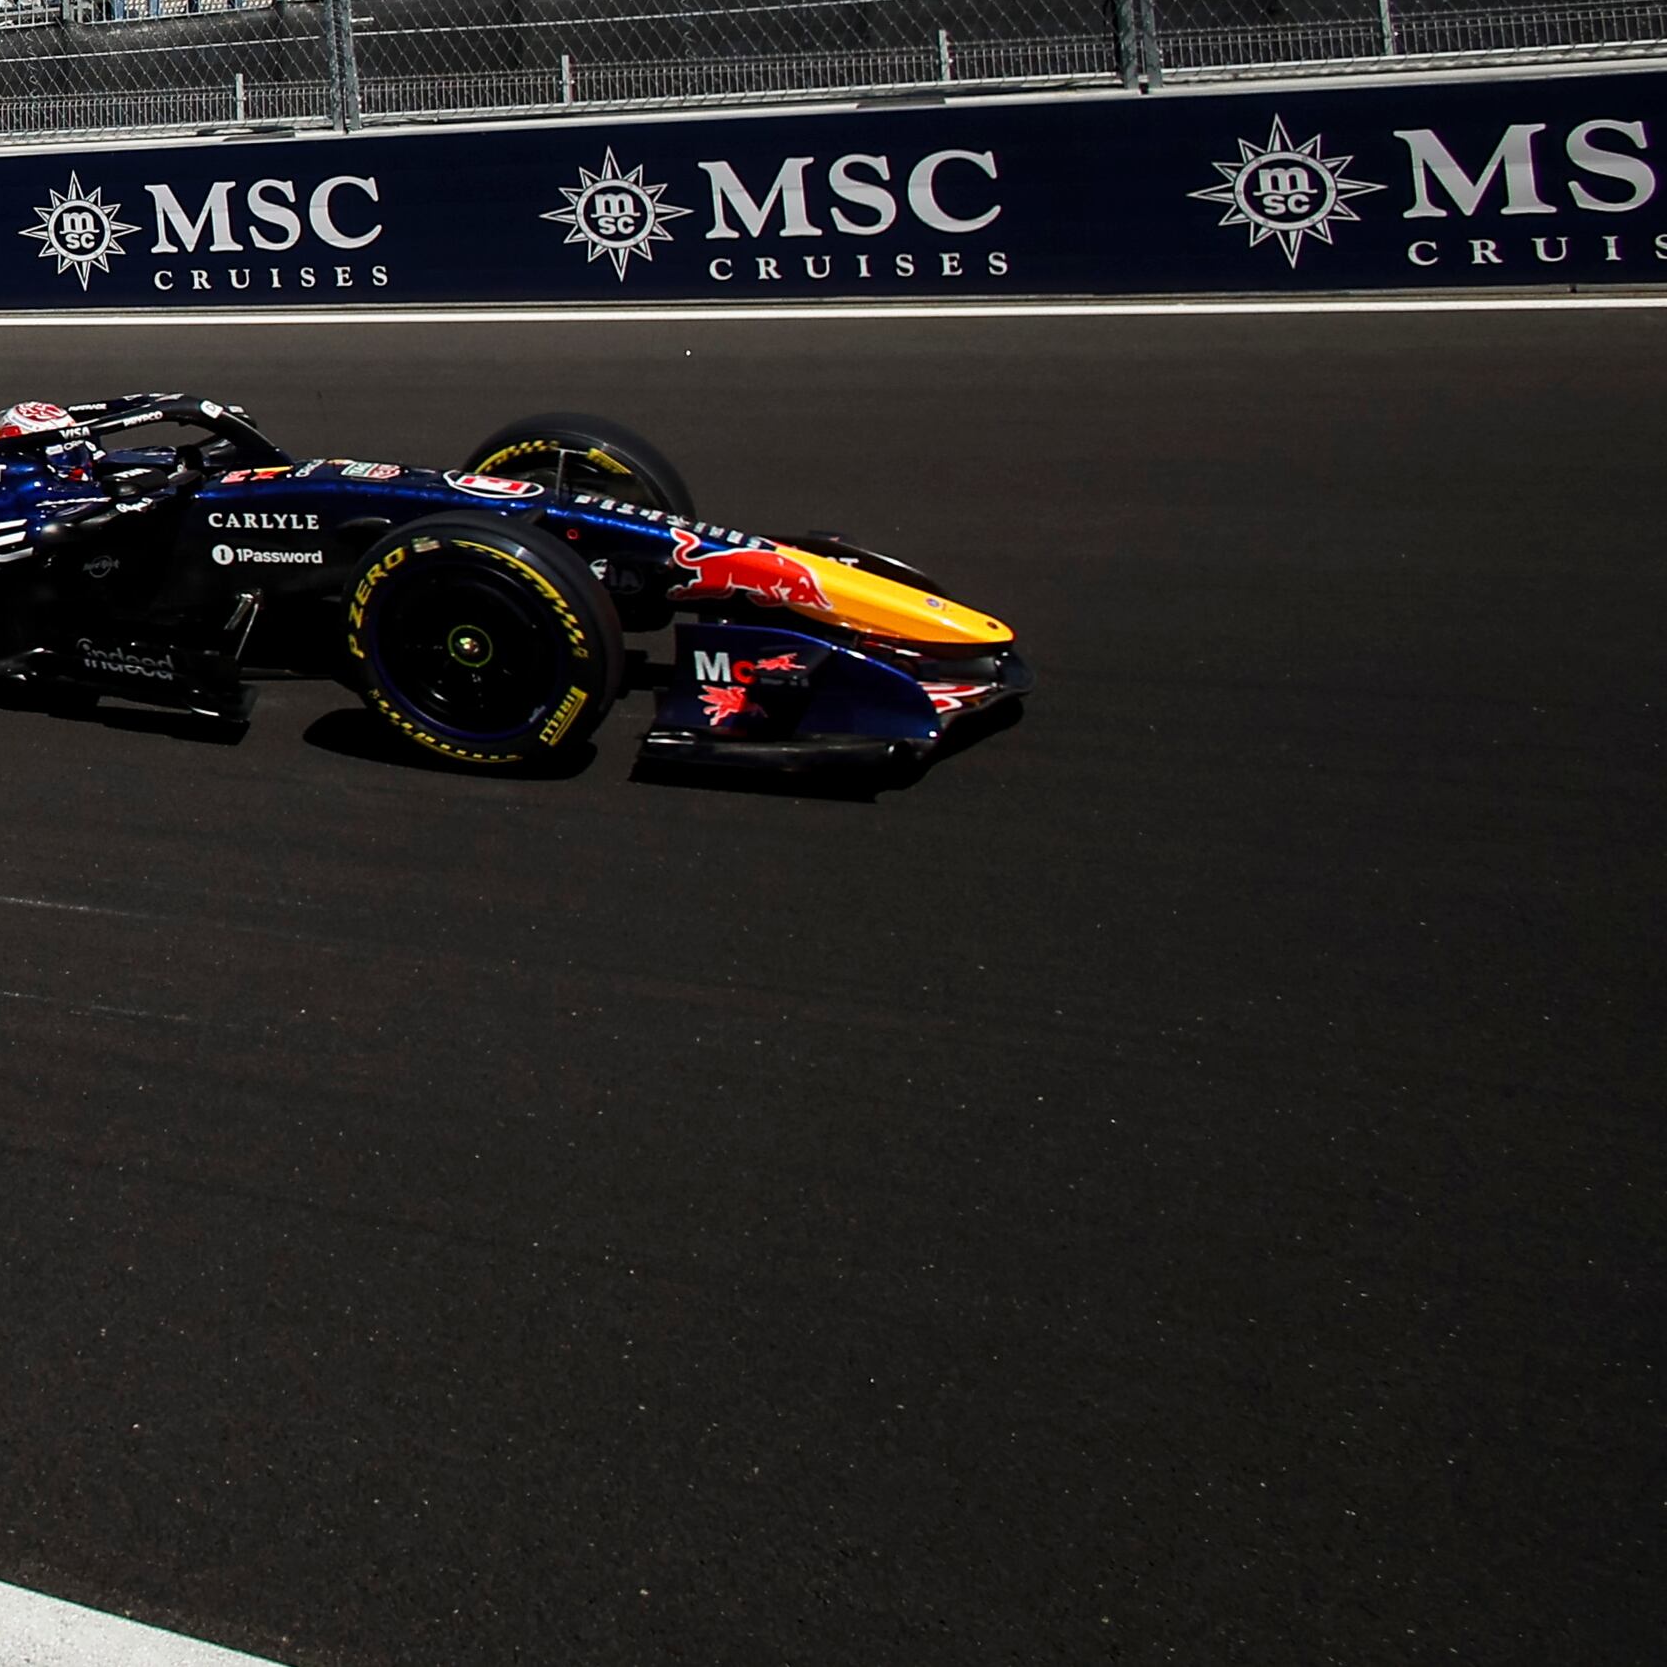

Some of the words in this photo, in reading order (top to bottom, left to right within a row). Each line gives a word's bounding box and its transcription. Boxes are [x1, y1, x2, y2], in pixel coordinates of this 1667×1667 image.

[1393, 119, 1656, 218] MS
[698, 150, 1002, 239] MSC
[145, 176, 383, 253] MSC
[1408, 234, 1667, 265] CRUIS
[155, 266, 388, 290] CRUISES
[710, 252, 1008, 280] CRUISES
[59, 426, 91, 440] VISA
[208, 512, 320, 530] CARLYLE
[235, 548, 323, 565] 1Password
[348, 547, 406, 630] ZERO
[539, 686, 589, 747] PIRELLI
